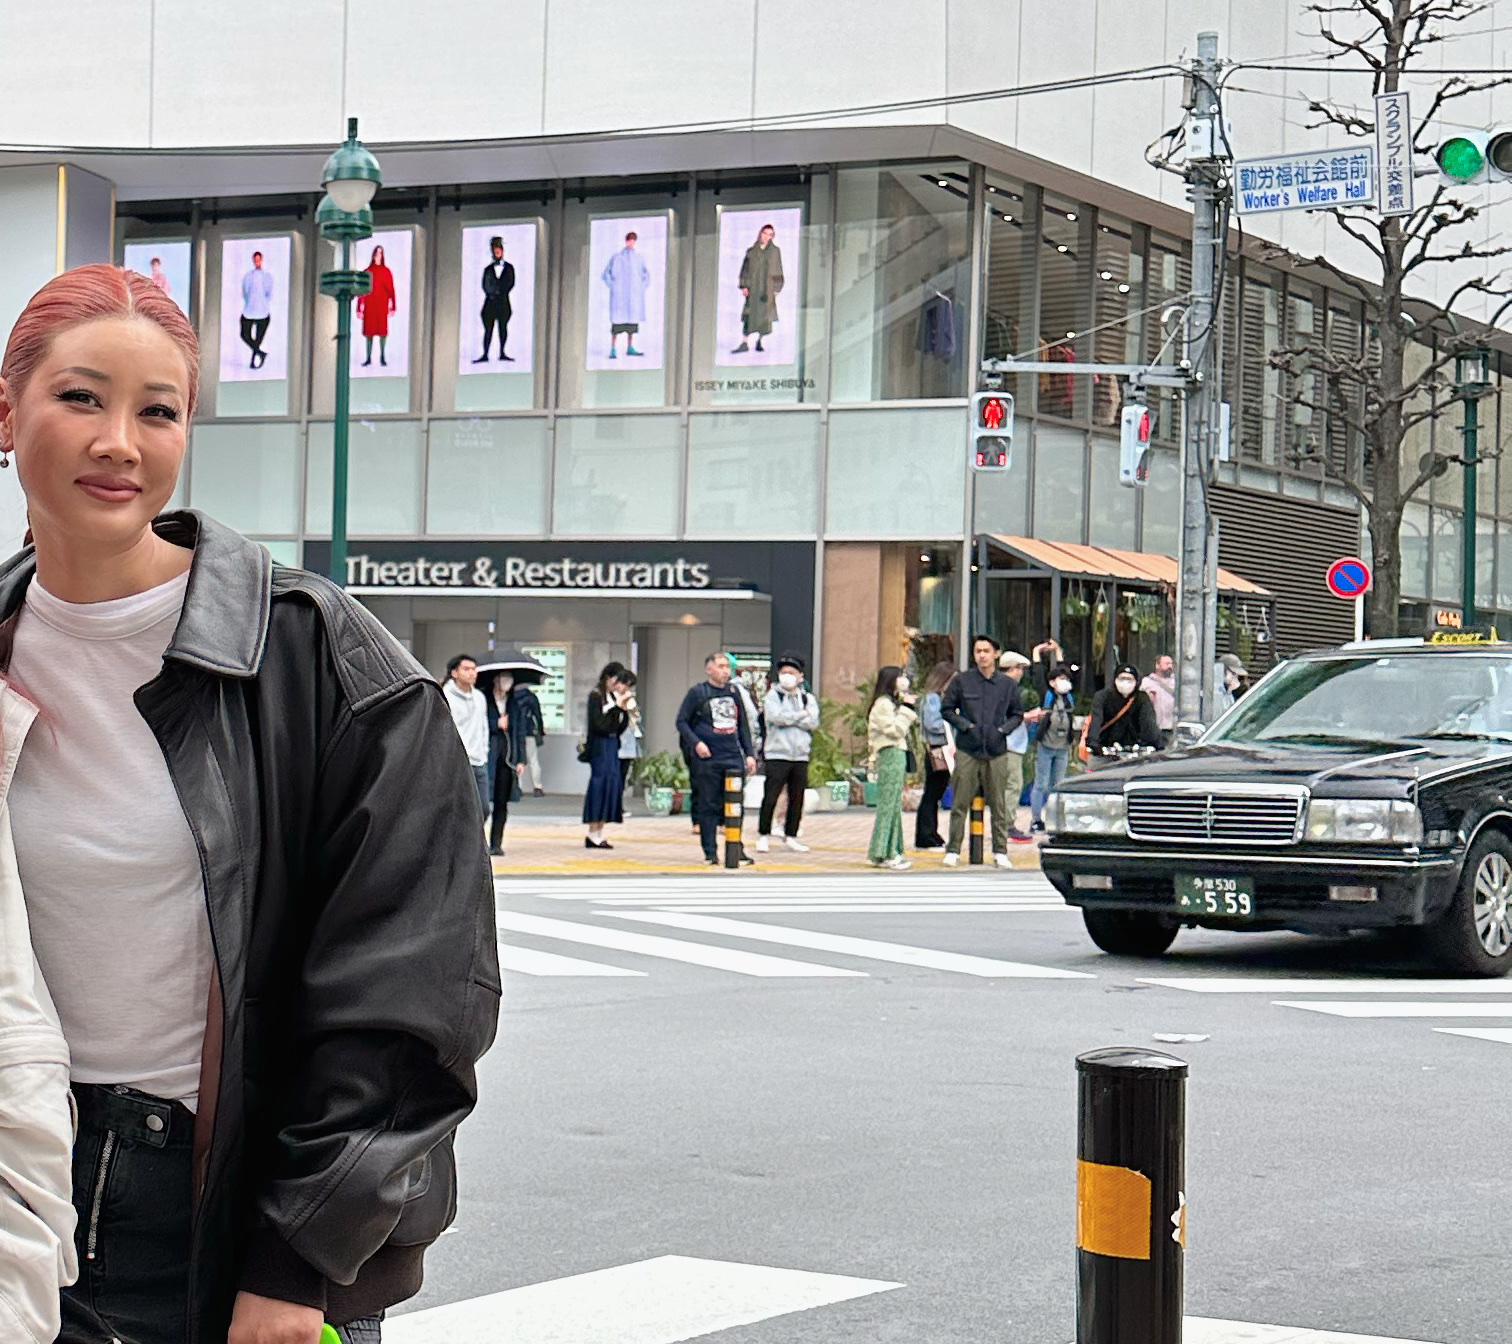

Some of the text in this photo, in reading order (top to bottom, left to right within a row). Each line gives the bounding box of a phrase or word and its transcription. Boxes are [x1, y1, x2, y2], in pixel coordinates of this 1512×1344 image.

[1240, 153, 1368, 192] 勤労福祉会館前
[1243, 180, 1366, 209] Worker's Welfare Hall
[694, 378, 816, 391] ISSEY MIYAKE SHIBUYA
[346, 556, 710, 588] Theater & Restaurants
